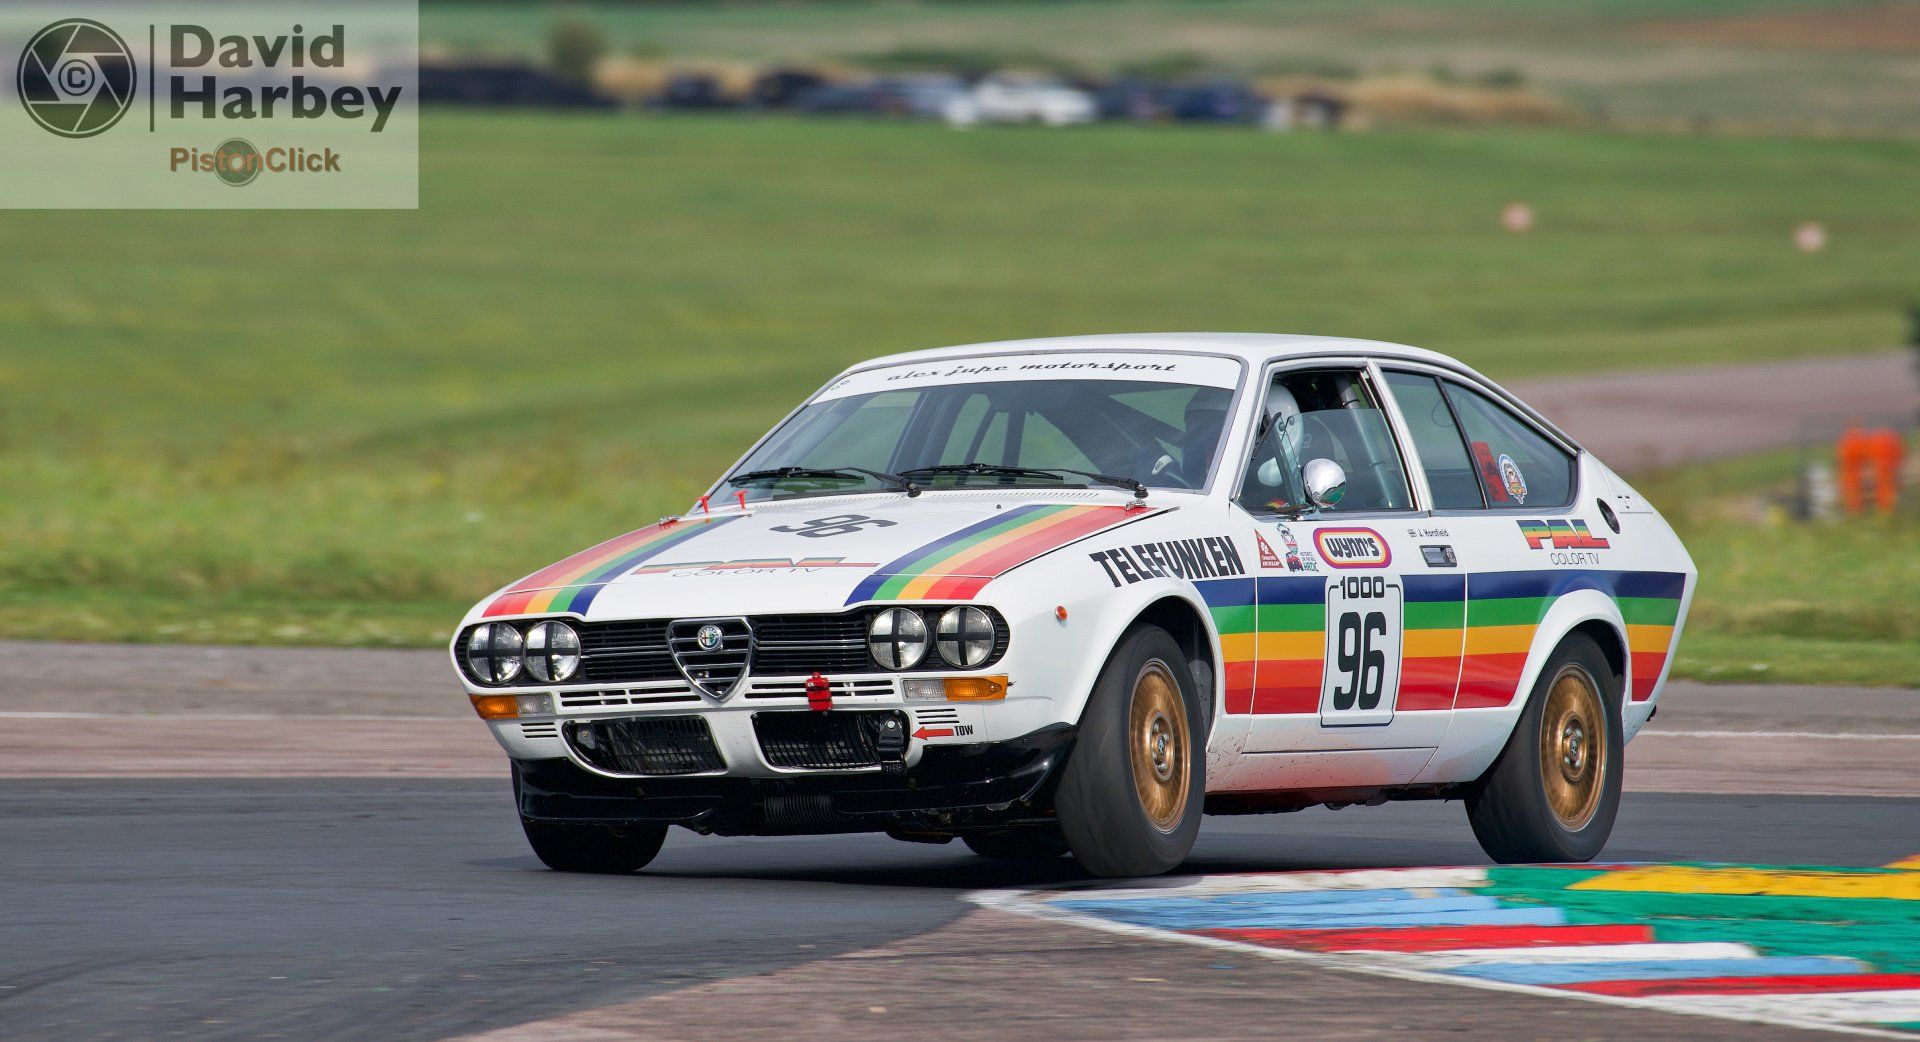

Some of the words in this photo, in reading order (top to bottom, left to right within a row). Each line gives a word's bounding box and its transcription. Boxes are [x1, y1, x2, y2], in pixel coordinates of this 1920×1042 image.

[887, 370, 941, 381] alex
[944, 365, 1008, 377] jupe
[1019, 361, 1177, 372] motorsport
[769, 514, 898, 538] 96
[1515, 519, 1611, 549] PAL
[630, 557, 881, 575] PAL
[1088, 535, 1246, 588] TELEFUNKEN
[1550, 553, 1586, 566] COLOR
[1586, 553, 1600, 565] TV
[672, 568, 777, 578] COLOR
[1337, 575, 1386, 600] 1000
[1332, 611, 1388, 711] 96
[954, 725, 973, 736] TOW
